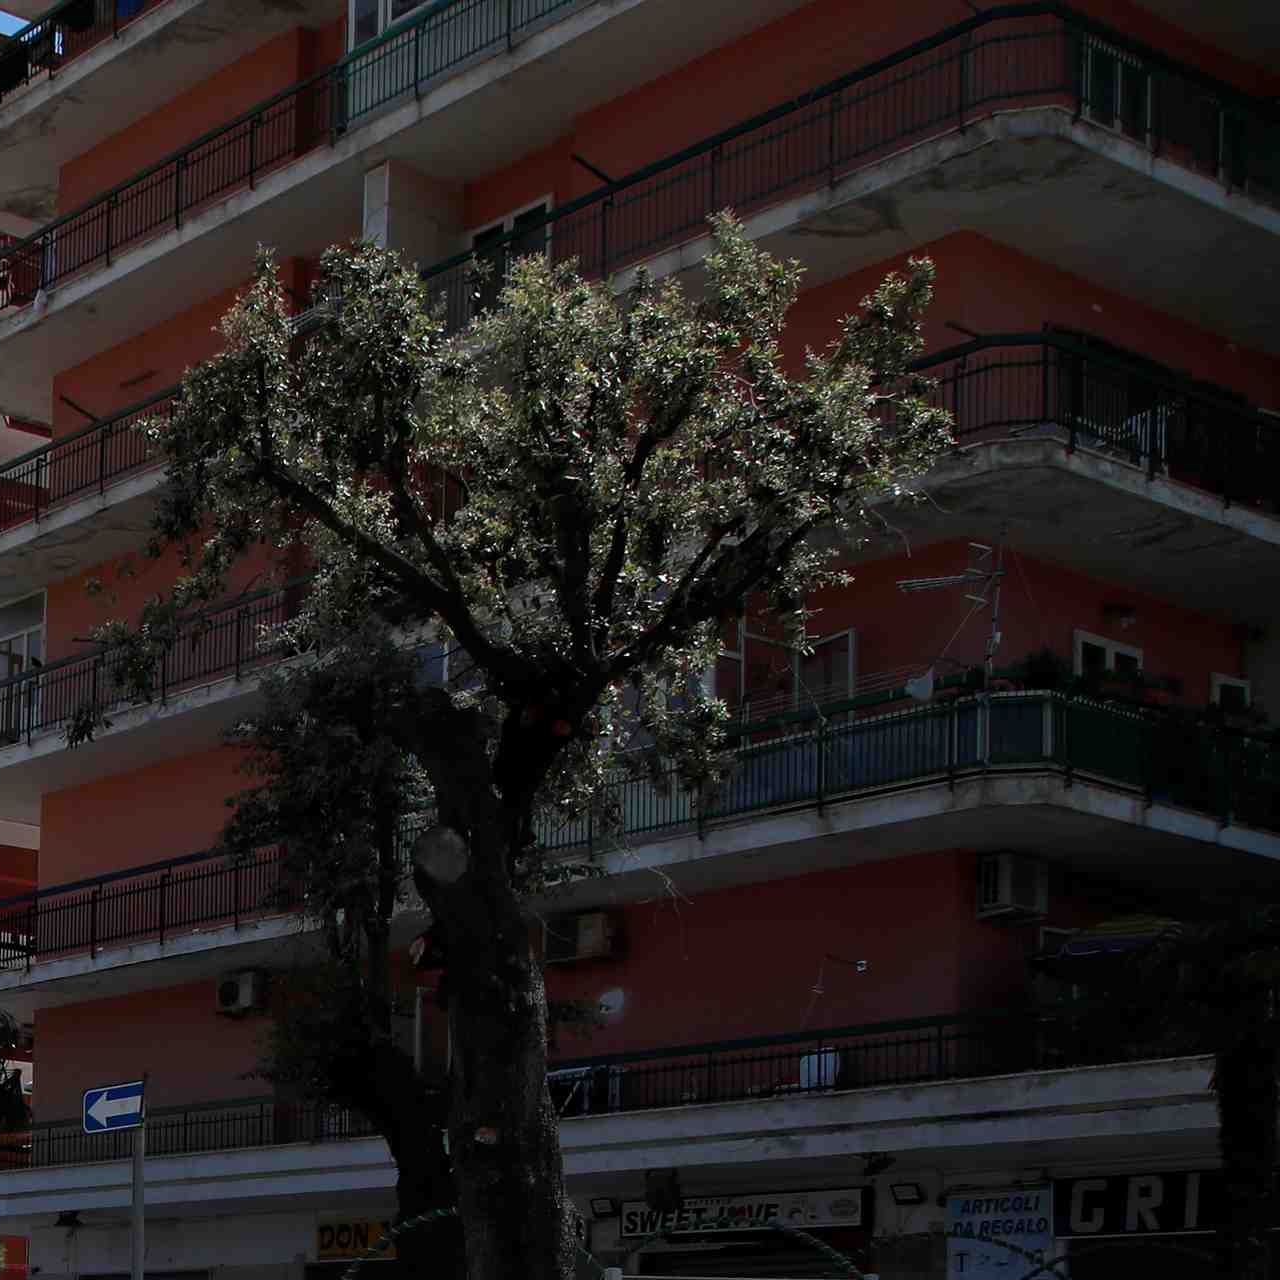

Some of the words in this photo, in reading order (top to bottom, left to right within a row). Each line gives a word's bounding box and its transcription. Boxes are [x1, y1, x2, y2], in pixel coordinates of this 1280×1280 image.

[960, 1195, 1040, 1215] ARTICOLI
[624, 1207, 708, 1234] SWEET
[952, 1220, 974, 1236] DA
[979, 1218, 1049, 1236] REGALO
[319, 1222, 368, 1249] DON
